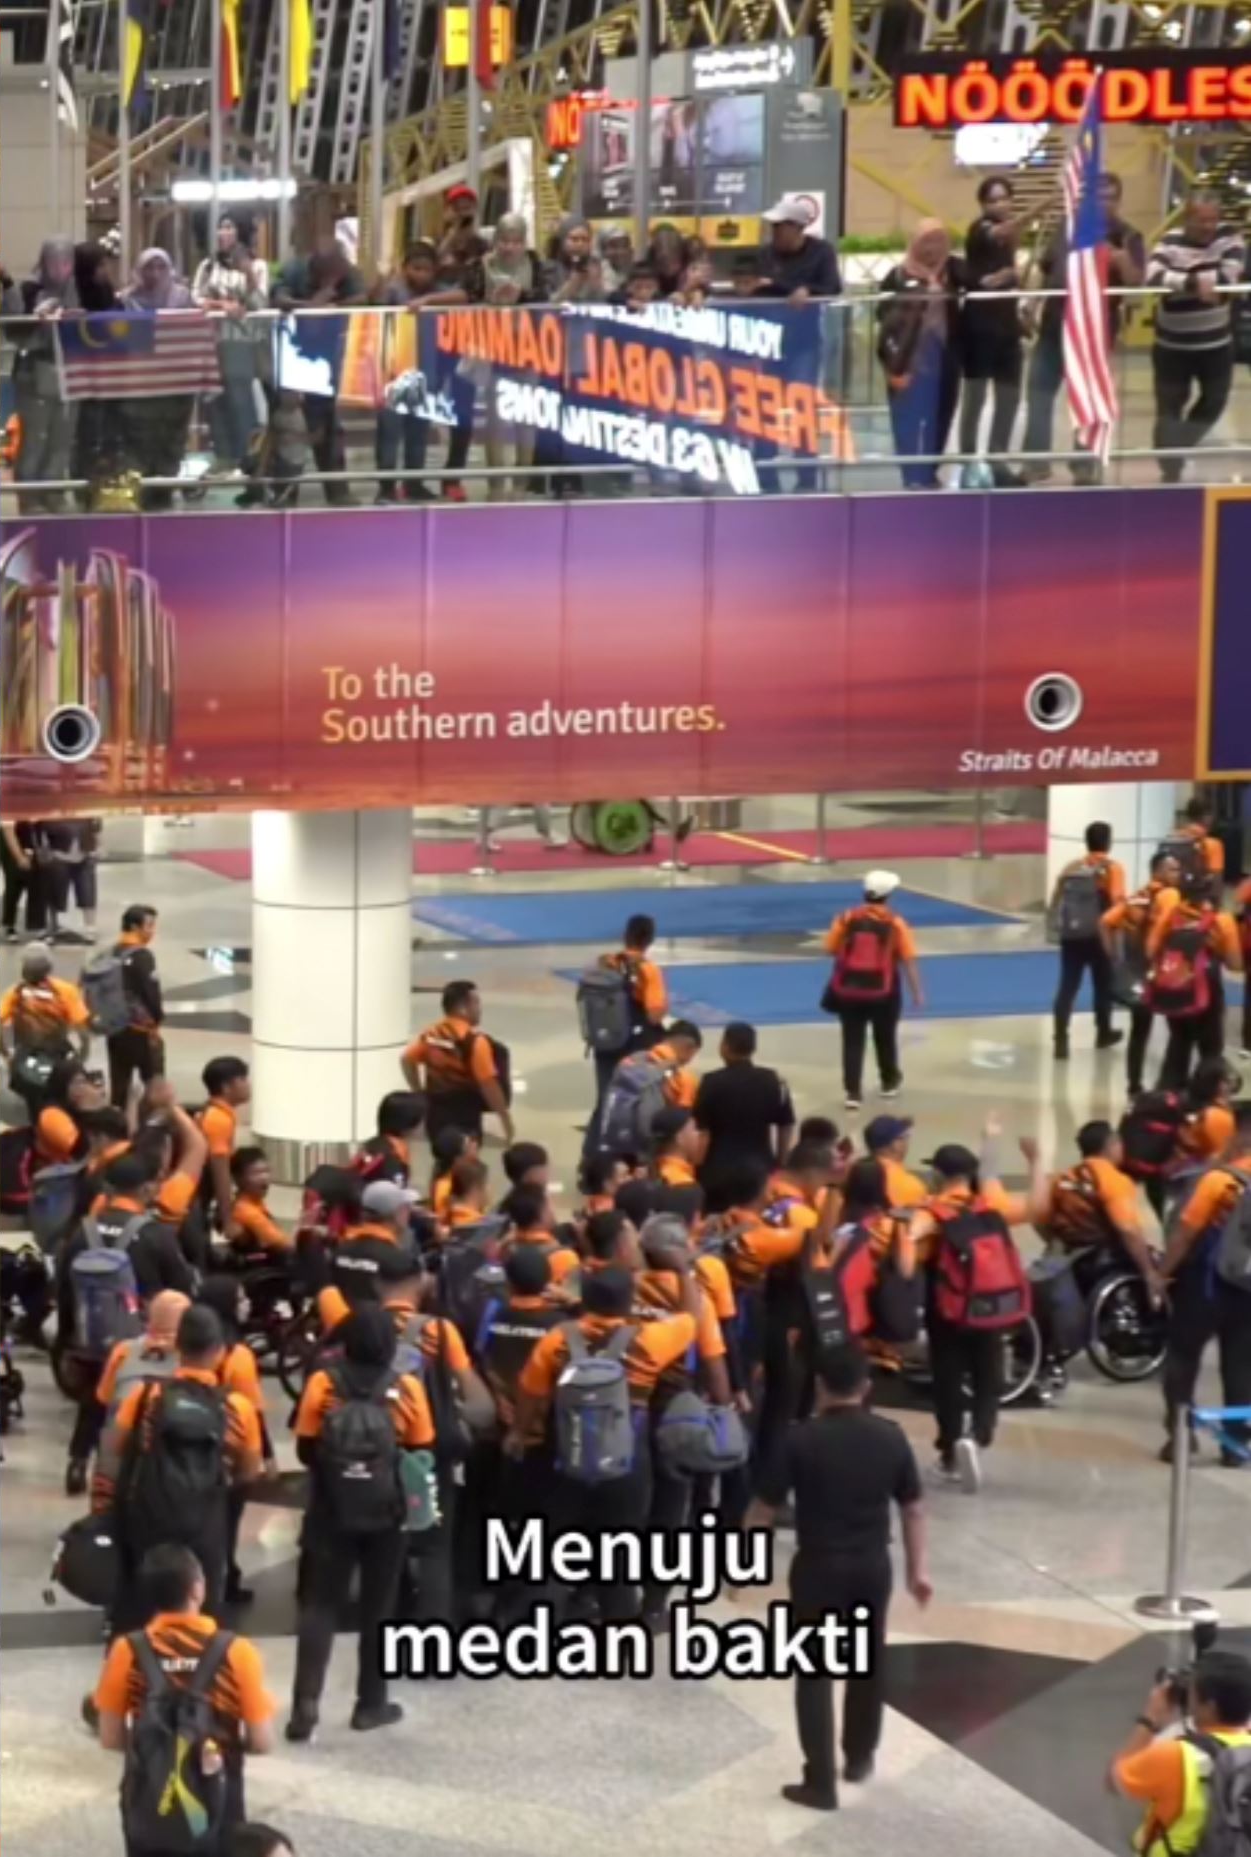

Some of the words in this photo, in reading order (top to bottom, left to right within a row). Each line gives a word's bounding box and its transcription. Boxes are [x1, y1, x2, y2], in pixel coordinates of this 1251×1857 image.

[321, 666, 362, 700] To
[374, 663, 435, 698] the
[321, 704, 496, 744] Southern
[506, 699, 726, 736] adventures.
[958, 749, 1032, 773] Straits
[1037, 746, 1068, 770] Of
[1069, 745, 1160, 769] Malacca
